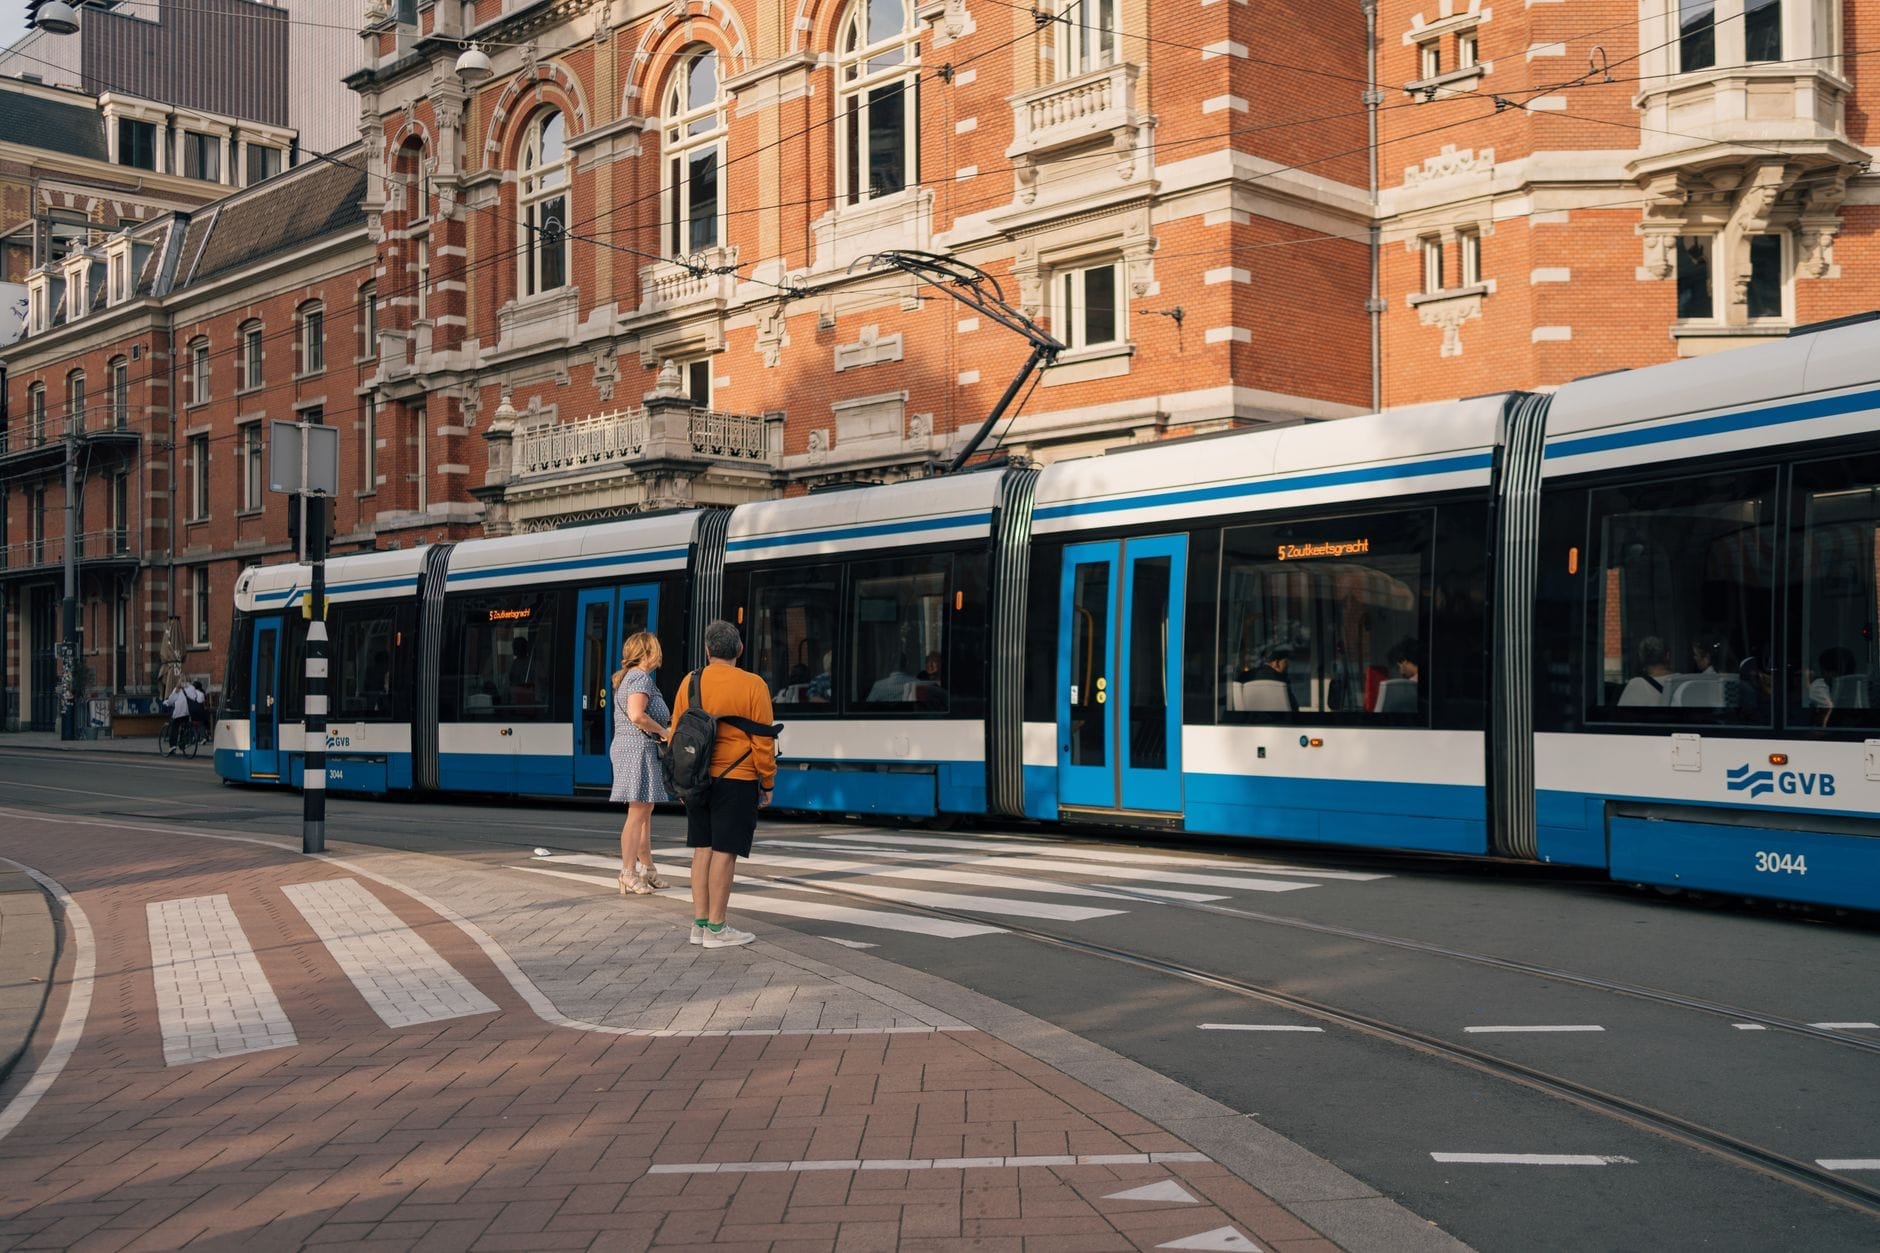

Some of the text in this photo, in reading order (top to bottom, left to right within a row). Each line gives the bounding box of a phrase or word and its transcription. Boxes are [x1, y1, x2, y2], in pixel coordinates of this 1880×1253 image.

[1278, 538, 1369, 561] 5 Zoutkeetsgracht
[335, 736, 350, 747] GVB
[1778, 771, 1836, 796] GVB
[1754, 851, 1808, 875] 3044
